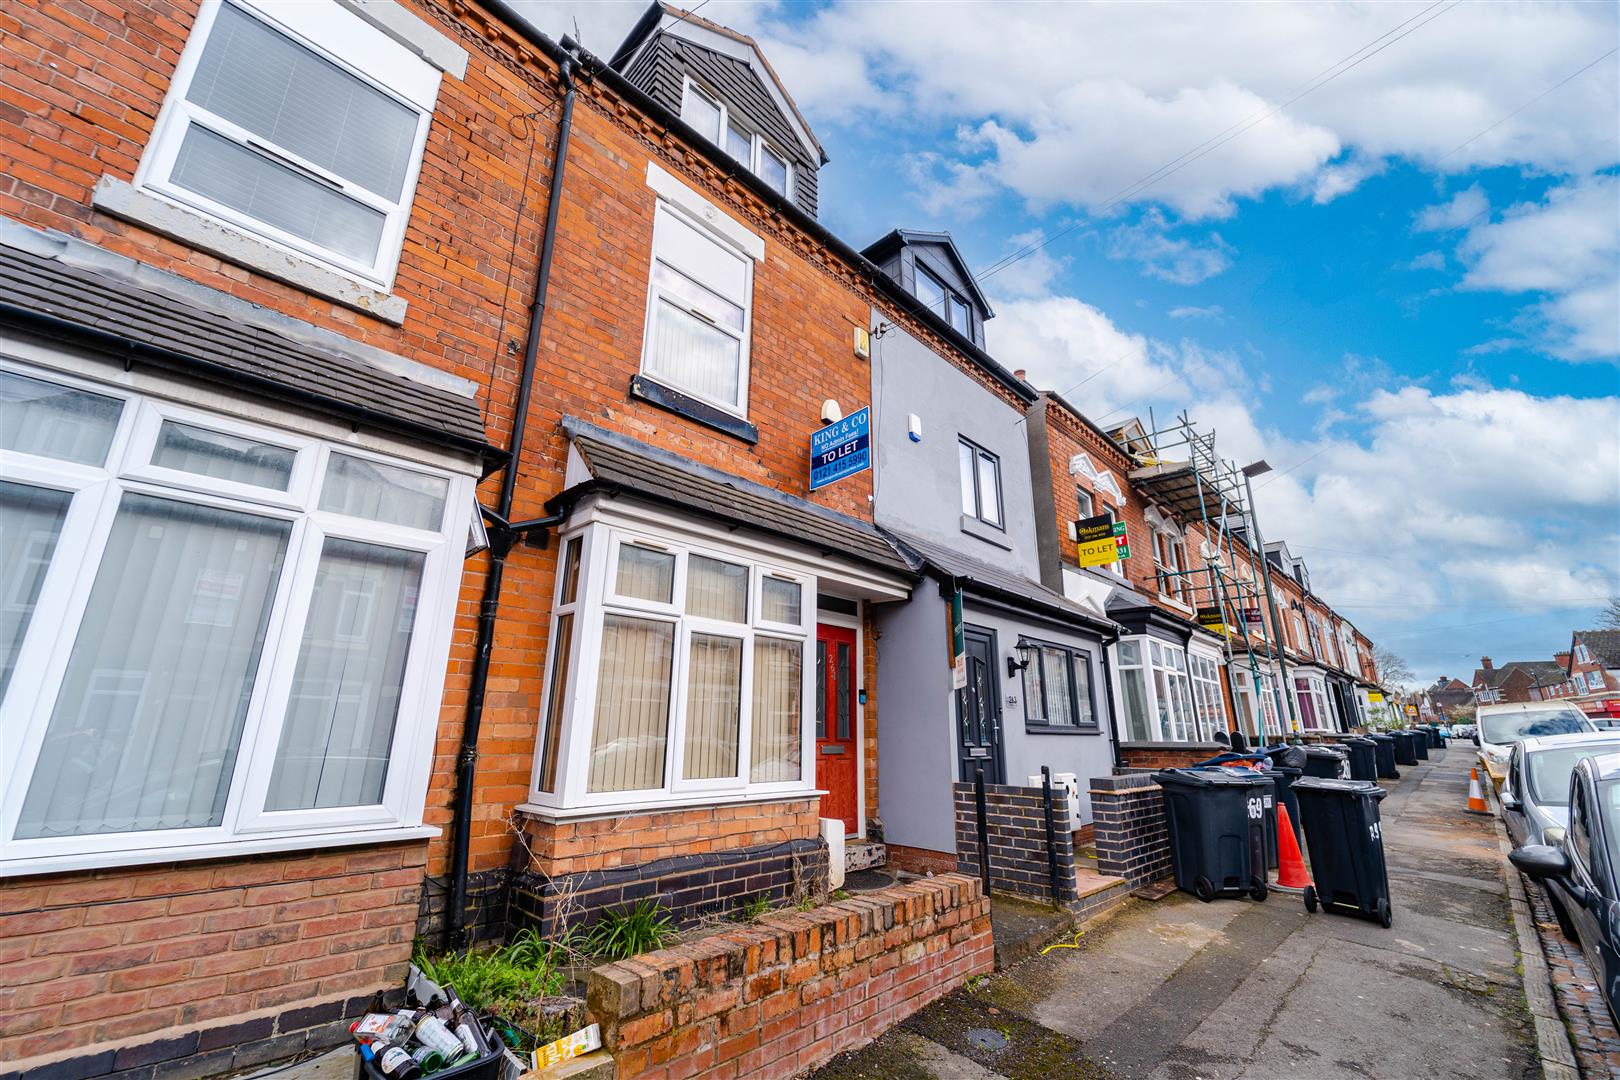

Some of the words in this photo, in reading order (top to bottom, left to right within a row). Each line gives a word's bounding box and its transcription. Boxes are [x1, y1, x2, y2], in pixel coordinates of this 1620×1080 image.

[814, 426, 838, 446] KING
[841, 422, 848, 433] &
[851, 413, 866, 427] CO
[821, 451, 836, 465] TO
[838, 440, 858, 458] LET
[813, 466, 831, 481] 0121
[848, 450, 867, 467] 5990
[1097, 544, 1113, 553] LET
[1247, 797, 1262, 819] 69
